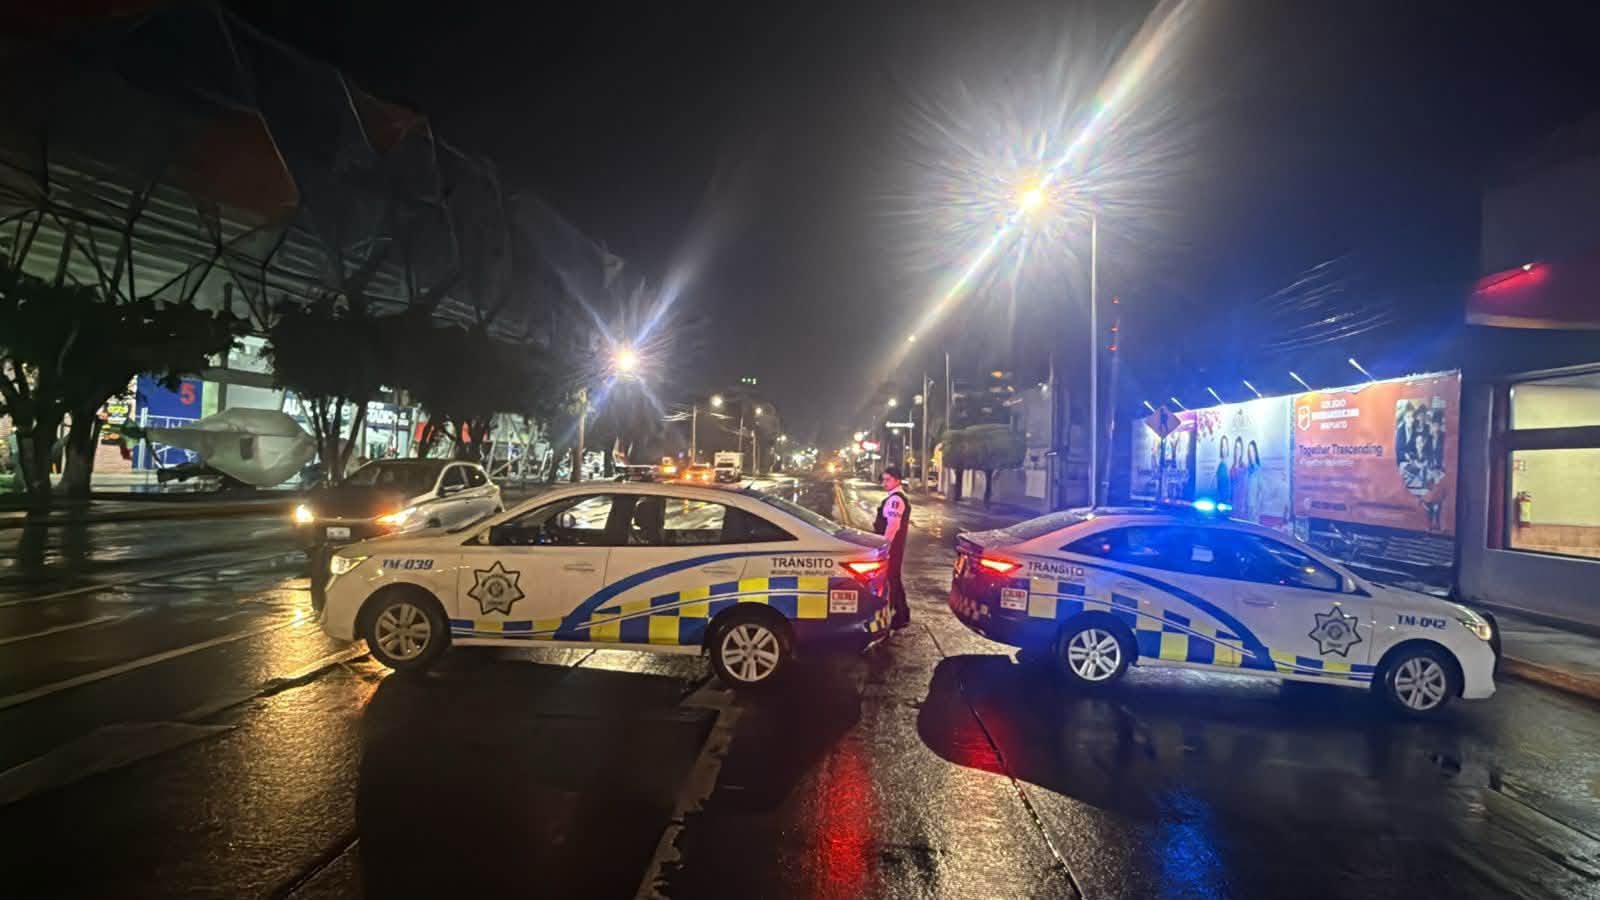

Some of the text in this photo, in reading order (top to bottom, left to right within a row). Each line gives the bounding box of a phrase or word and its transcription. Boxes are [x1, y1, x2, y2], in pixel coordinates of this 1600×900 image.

[180, 383, 195, 405] 5
[1299, 445, 1330, 458] Together
[383, 559, 434, 570] TM-039
[1397, 614, 1447, 629] TM-042
